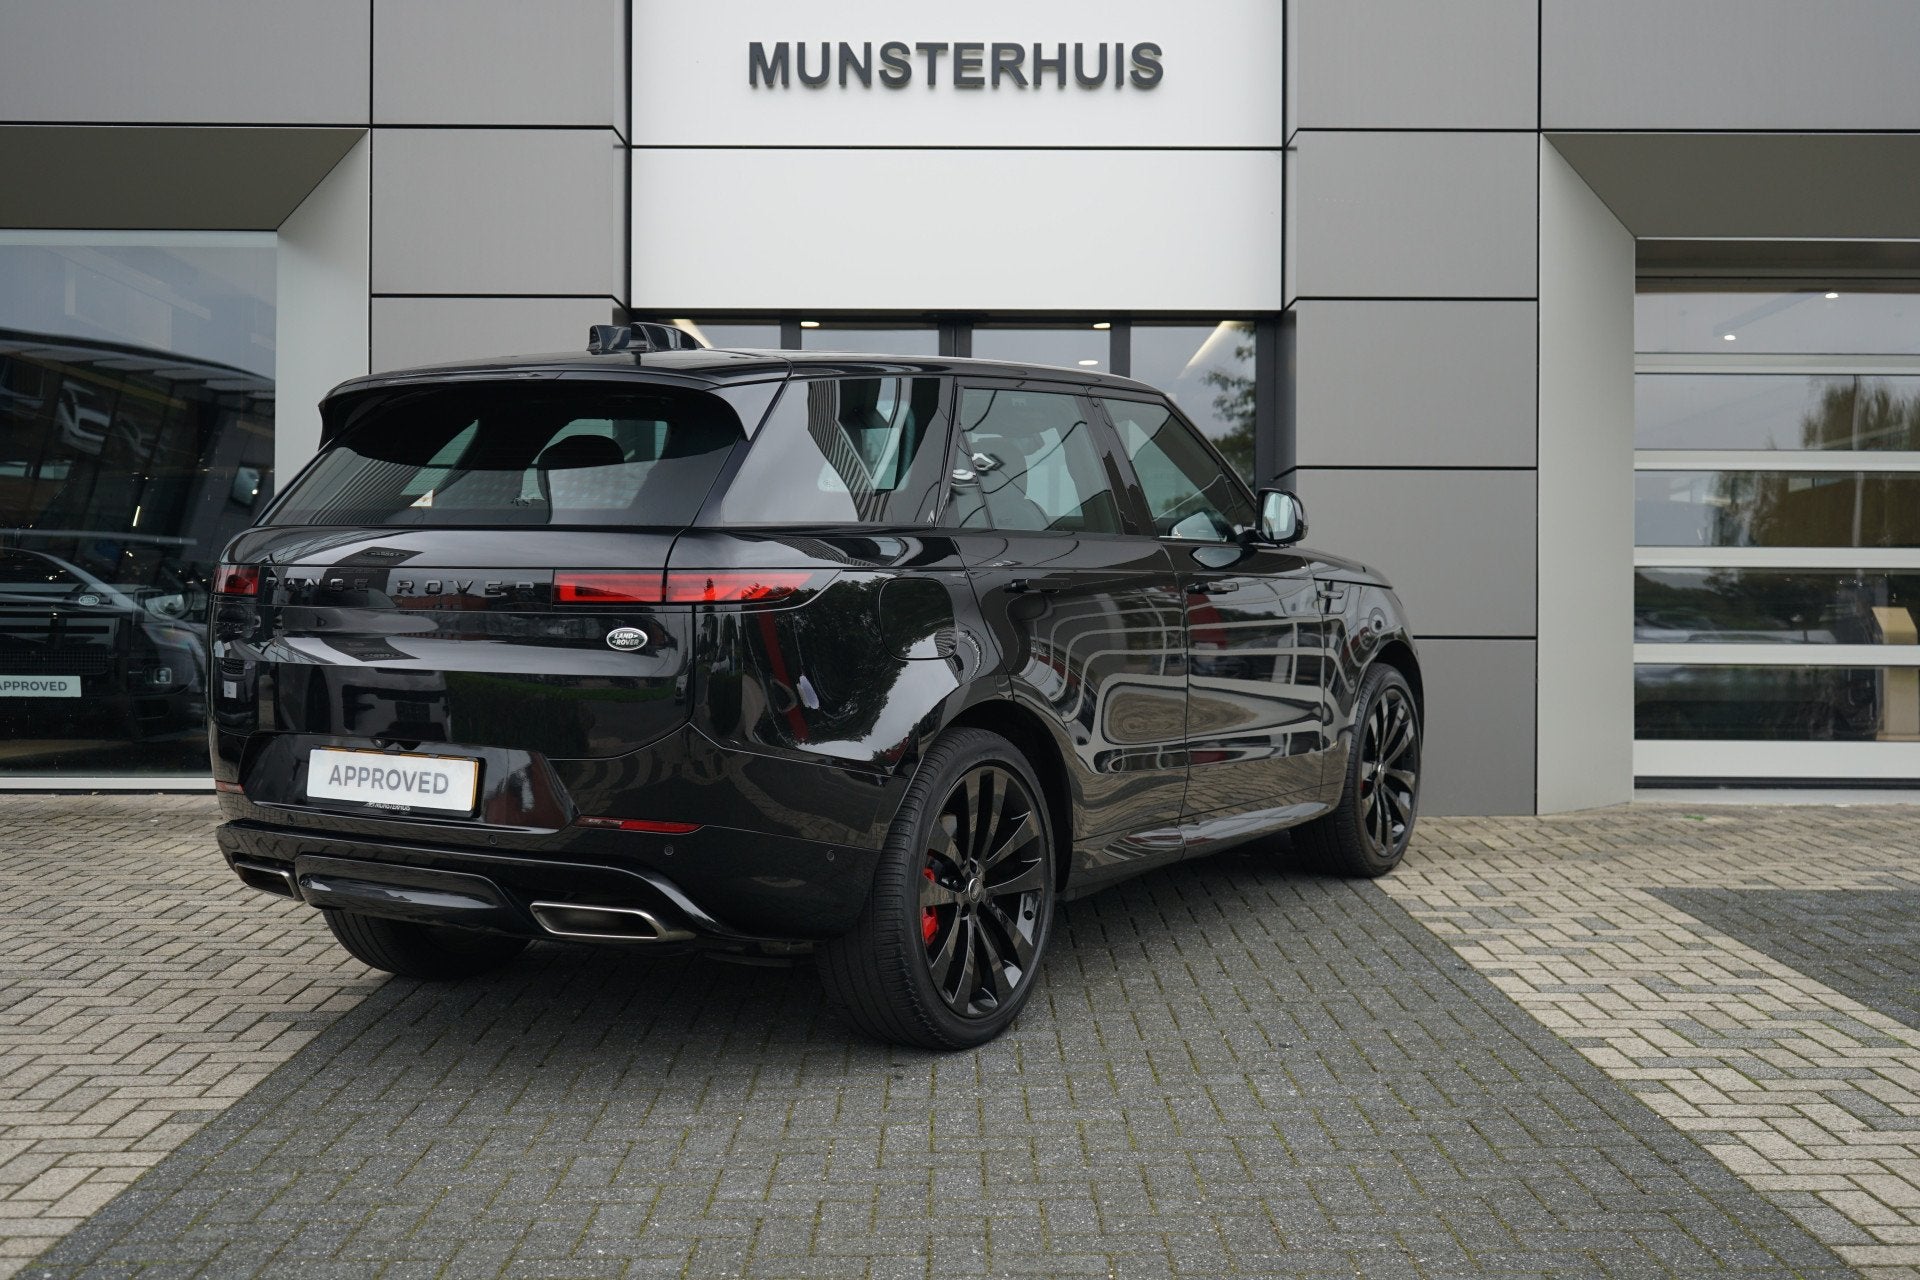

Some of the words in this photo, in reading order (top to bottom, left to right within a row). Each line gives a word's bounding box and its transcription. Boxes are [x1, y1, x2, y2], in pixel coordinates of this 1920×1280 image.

[749, 41, 1164, 88] MUNSTERHUIS
[265, 576, 369, 592] RANGE
[397, 579, 535, 595] ROVER
[328, 764, 449, 795] APPROVED
